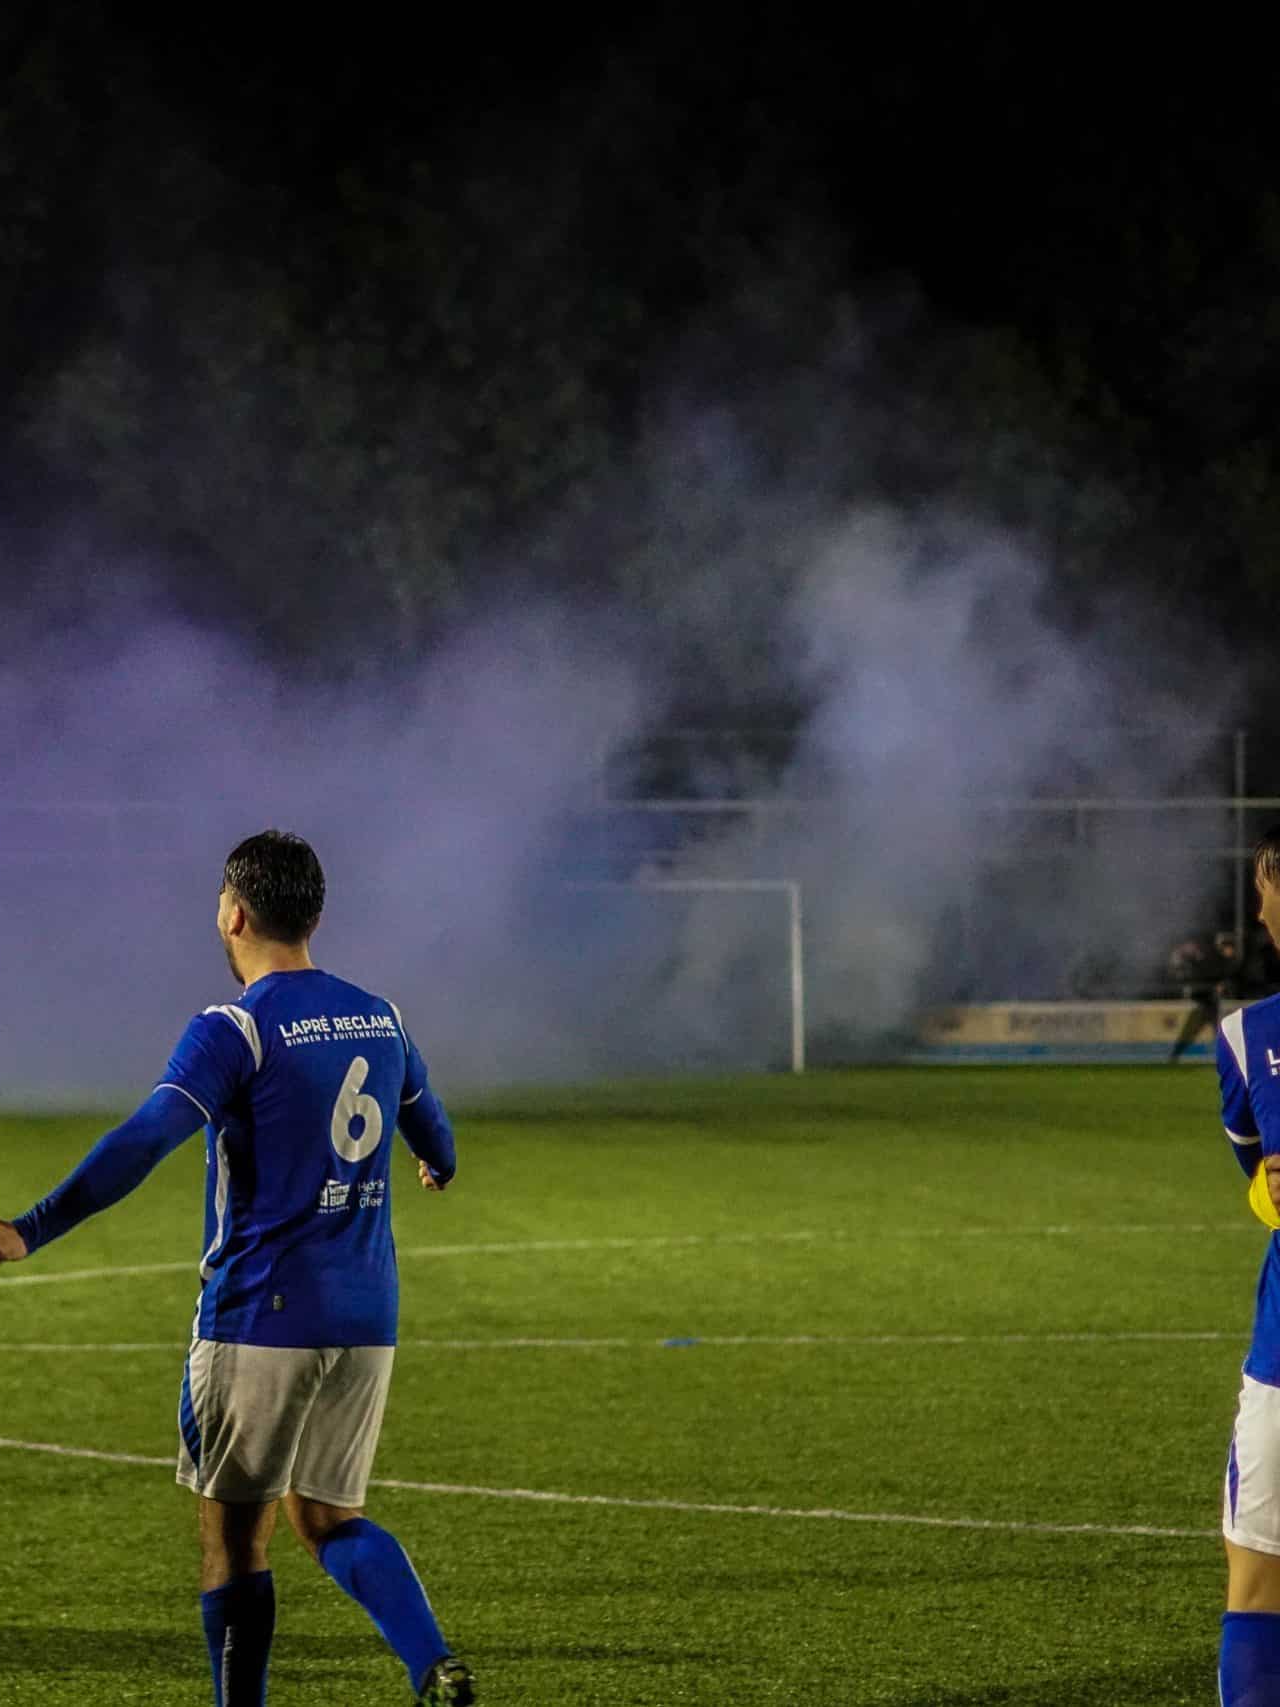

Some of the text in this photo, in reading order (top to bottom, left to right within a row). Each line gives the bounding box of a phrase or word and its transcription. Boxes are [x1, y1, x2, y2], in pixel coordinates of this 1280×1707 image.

[279, 1015, 395, 1039] LAPRÉ RECLAME
[285, 1034, 321, 1048] BINNEN
[330, 1056, 383, 1162] 6
